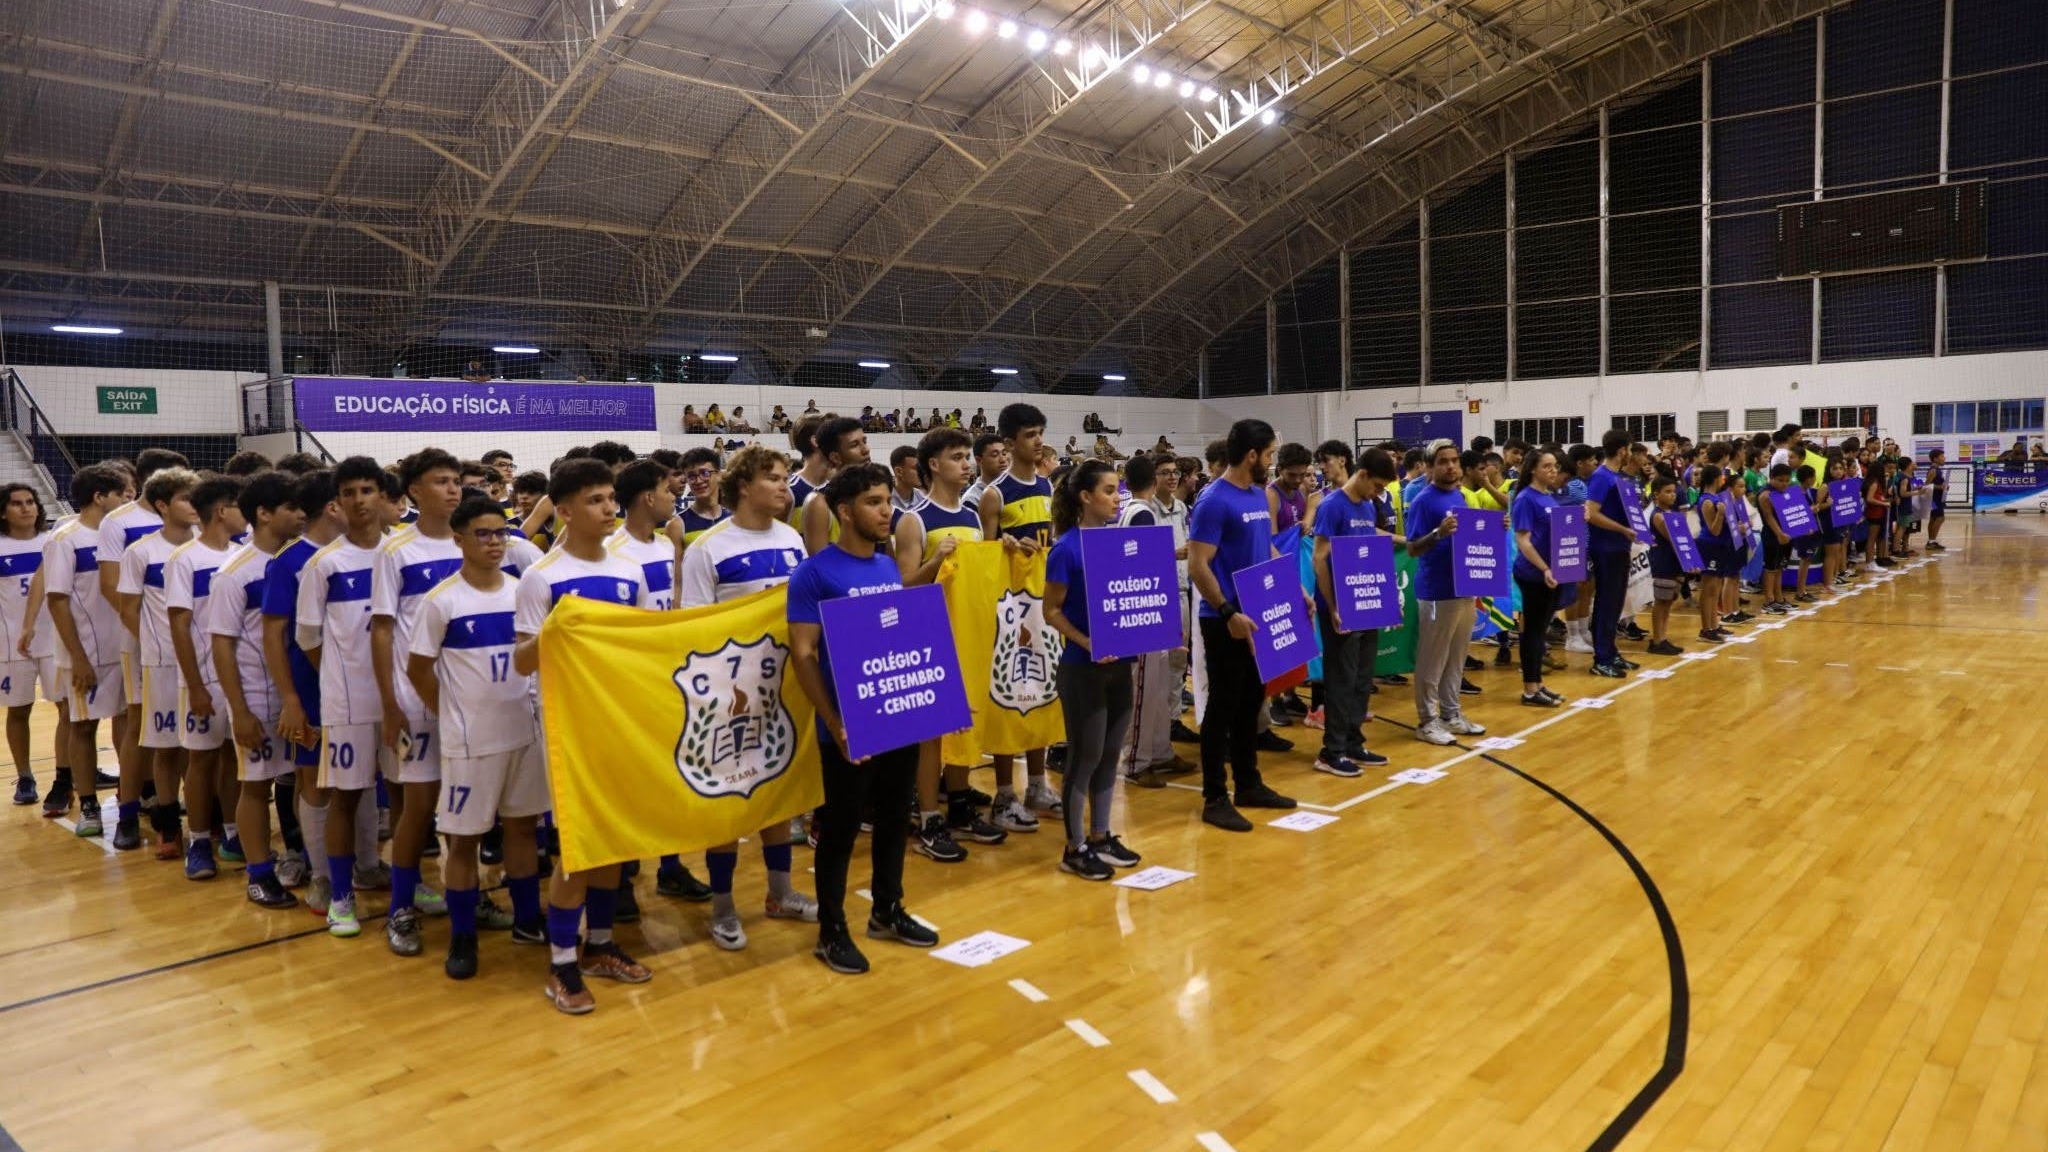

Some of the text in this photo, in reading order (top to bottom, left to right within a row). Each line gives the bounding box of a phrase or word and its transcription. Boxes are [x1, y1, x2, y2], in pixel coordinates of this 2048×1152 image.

[106, 389, 148, 400] SAÍDA
[113, 401, 143, 410] EXIT
[335, 393, 628, 417] EDUCAÇÃO FÍSICA É NA MELHOR
[1995, 476, 2037, 484] FEVECE
[1467, 544, 1493, 555] COLÉGIO
[1464, 557, 1496, 567] MONTEIRO
[1345, 572, 1386, 585] COLÉGIO DA
[1469, 569, 1493, 579] LOBATO
[1108, 575, 1160, 594] COLÉGIO 7
[1353, 585, 1381, 598] POLÍCIA
[1103, 593, 1168, 612] DE SETEMBRO
[1262, 601, 1292, 623] COLÉGIO
[1355, 598, 1382, 611] MILITAR
[1005, 602, 1031, 625] C 7
[1120, 611, 1162, 629] ALDEOTA
[1269, 618, 1293, 636] SANTA
[1273, 632, 1298, 651] CECÍLIA
[490, 652, 509, 682] 17
[862, 647, 933, 676] COLÉGIO 7
[692, 656, 777, 696] C 7 S
[857, 665, 946, 700] DE SETEMBRO
[884, 689, 936, 715] CENTRO
[154, 711, 176, 732] 04
[329, 743, 354, 769] 20
[449, 785, 471, 815] 17
